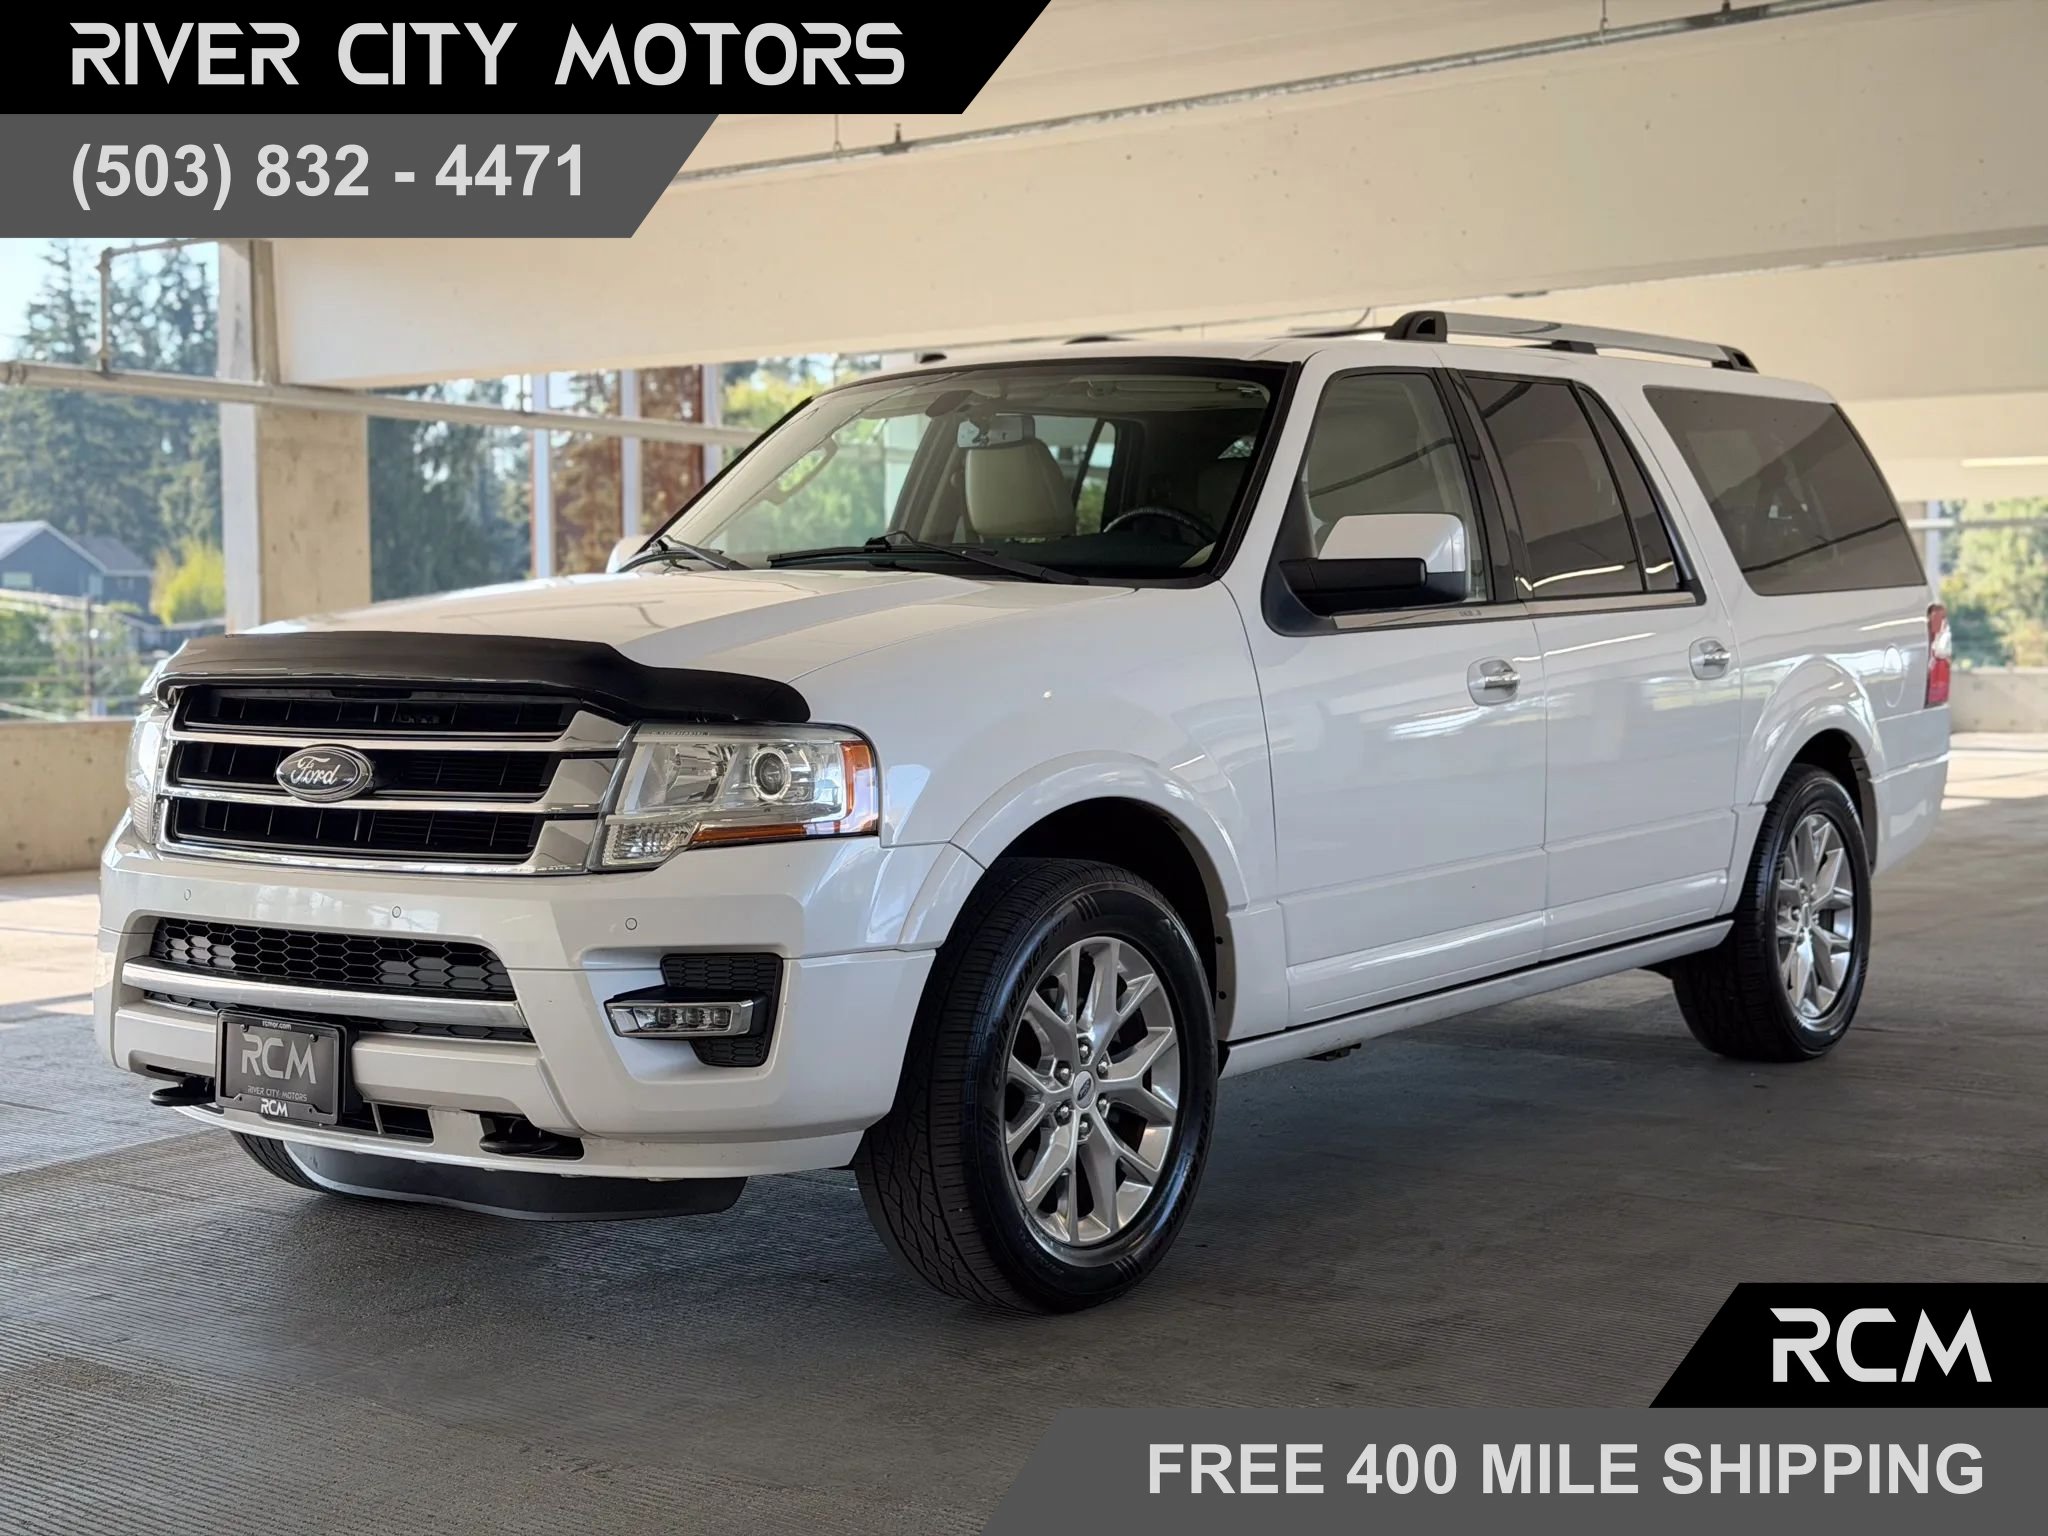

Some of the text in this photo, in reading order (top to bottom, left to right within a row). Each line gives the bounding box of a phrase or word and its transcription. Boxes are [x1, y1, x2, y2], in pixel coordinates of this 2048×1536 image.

[288, 755, 341, 786] Ford
[240, 1032, 317, 1084] RCM
[247, 1085, 308, 1102] RIVER CITY MOTORS
[260, 1098, 288, 1118] RCM
